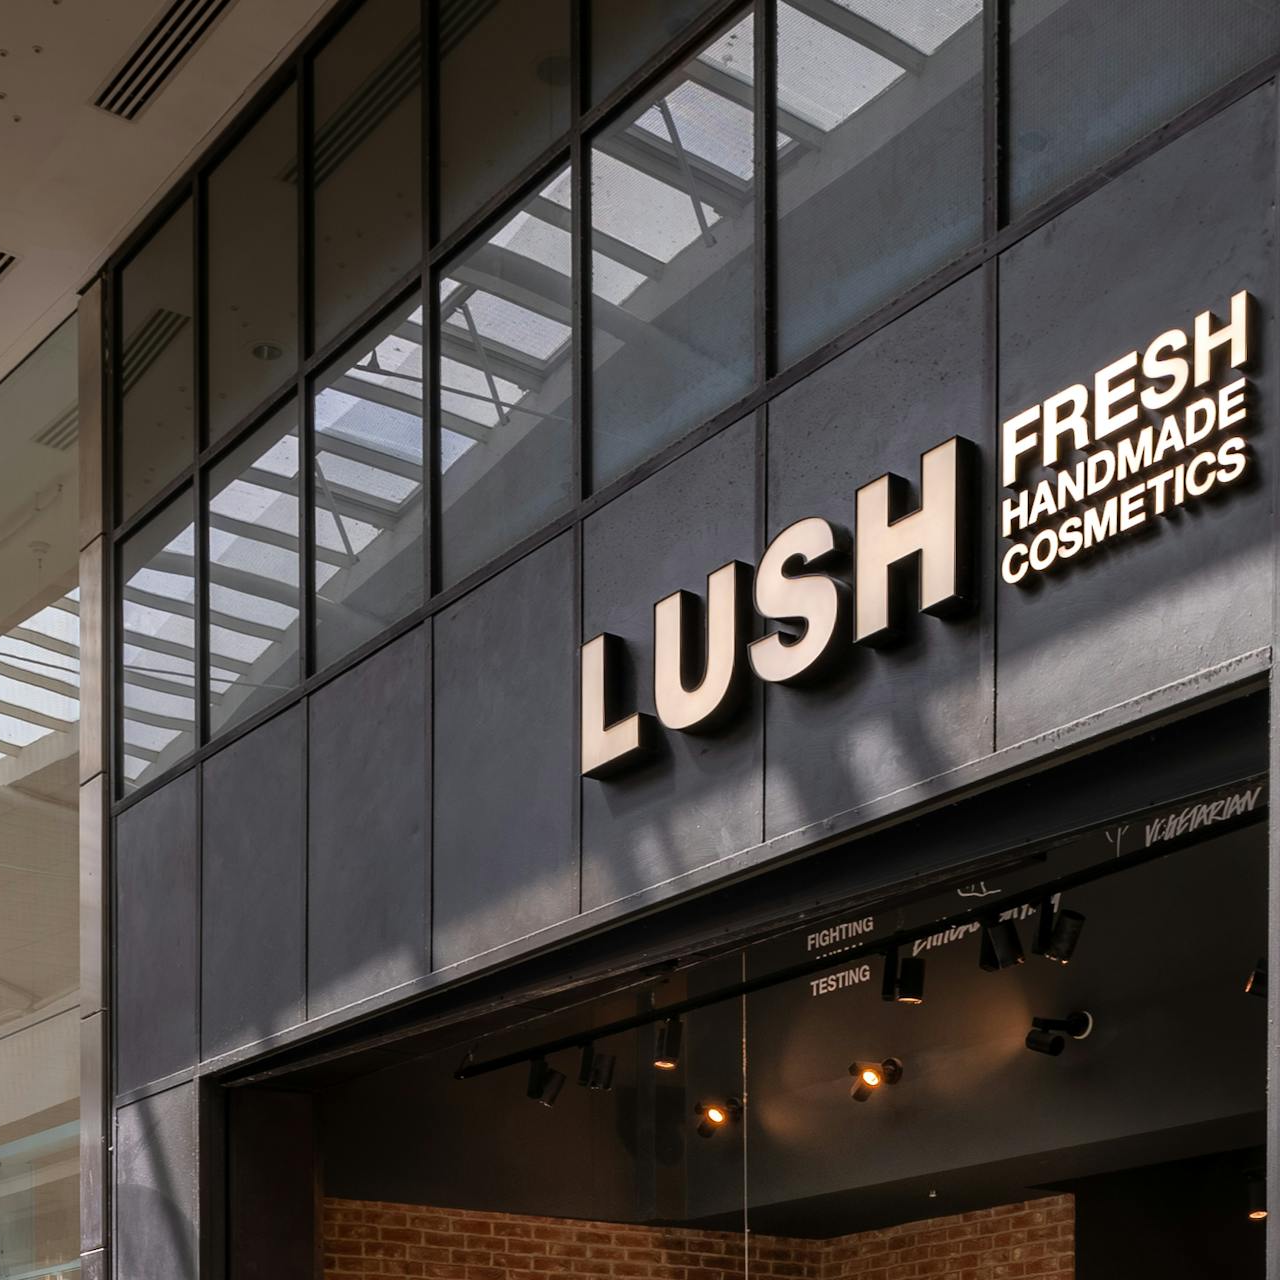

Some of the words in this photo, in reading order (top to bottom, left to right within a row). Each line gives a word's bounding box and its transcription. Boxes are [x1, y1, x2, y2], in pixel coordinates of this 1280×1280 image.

[1002, 291, 1249, 487] FRESH
[1002, 378, 1246, 537] HANDMADE
[1001, 437, 1246, 586] COSMETICS
[581, 436, 960, 777] LUSH
[807, 917, 873, 950] FIGHTING
[810, 965, 870, 996] TESTING
